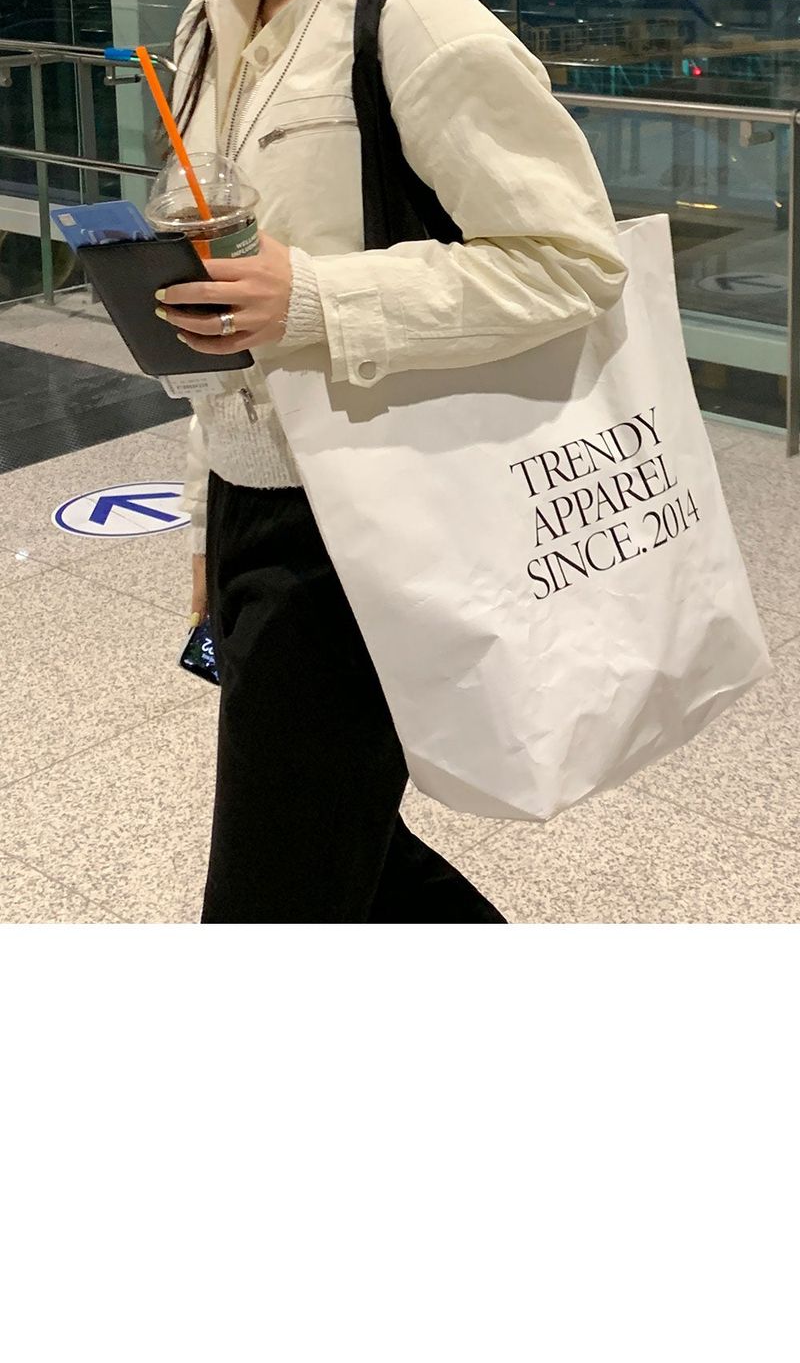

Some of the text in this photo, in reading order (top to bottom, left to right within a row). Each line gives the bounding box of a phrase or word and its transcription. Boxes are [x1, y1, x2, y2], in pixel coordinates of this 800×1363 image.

[509, 406, 662, 498] TRENDY
[527, 489, 700, 600] SINCE. 2014
[535, 454, 678, 548] APPAREL
